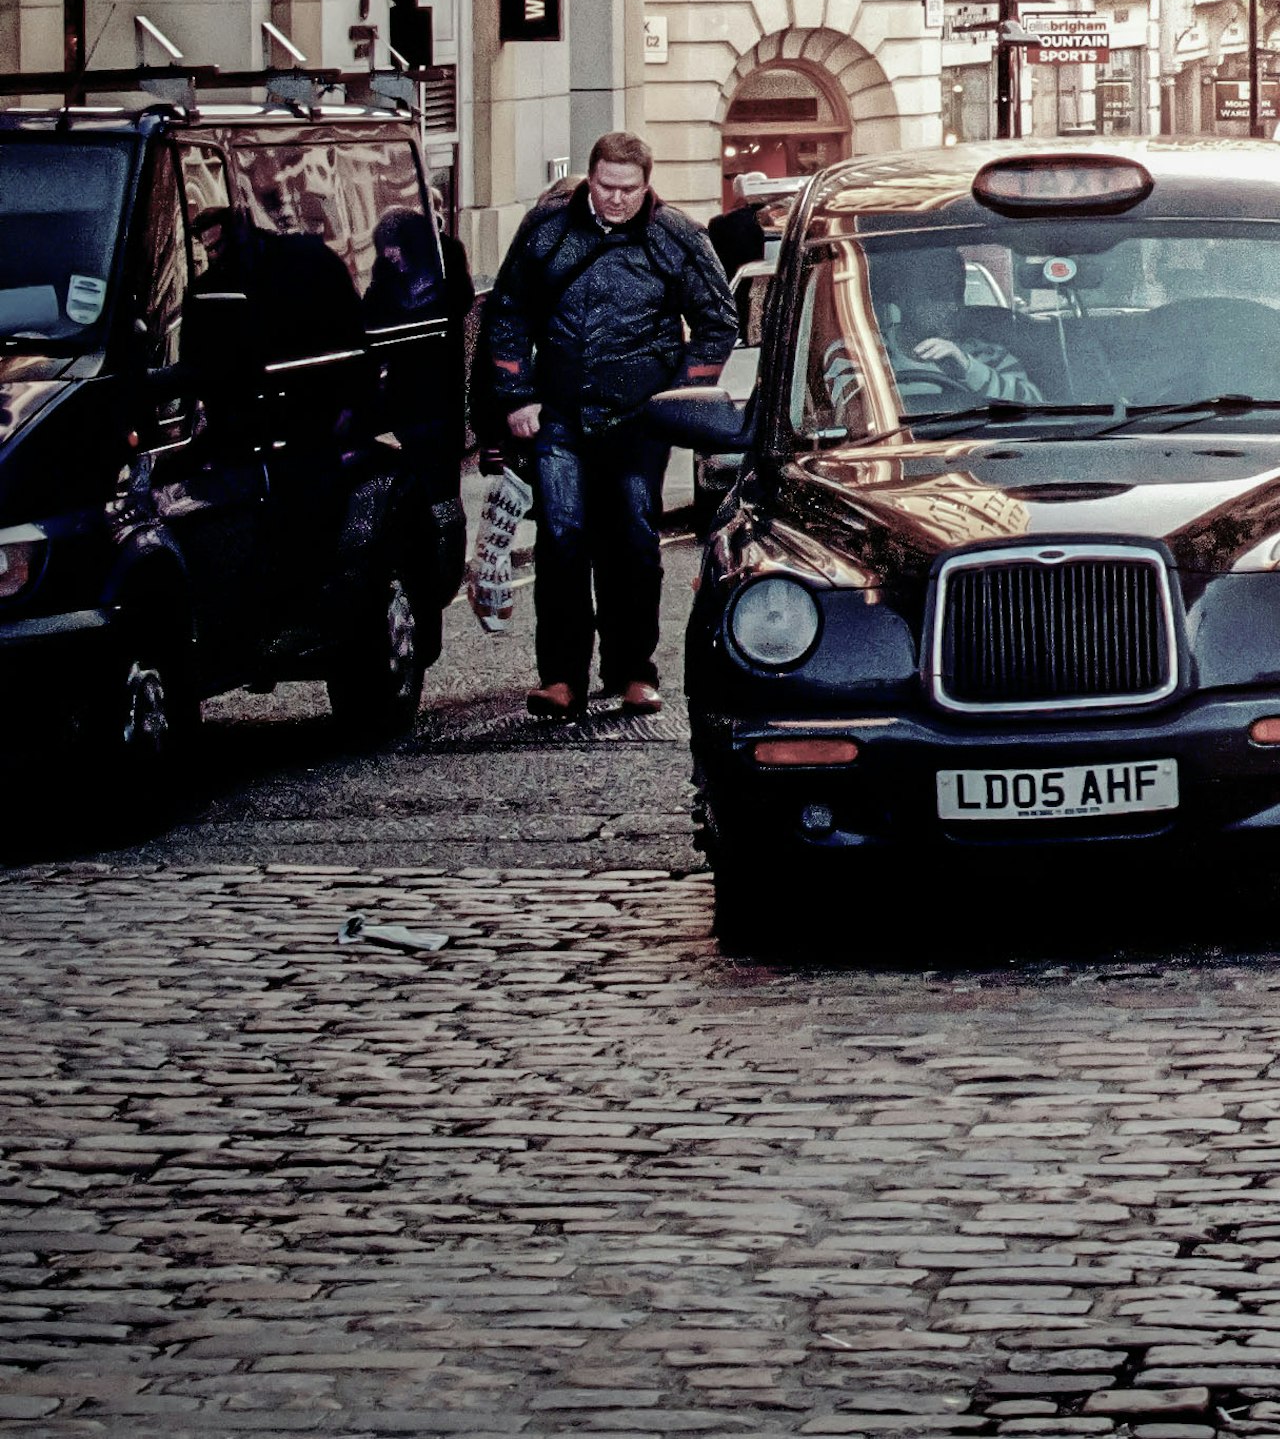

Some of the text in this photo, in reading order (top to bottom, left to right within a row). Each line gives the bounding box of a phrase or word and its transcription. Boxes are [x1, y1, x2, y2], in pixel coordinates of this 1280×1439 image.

[1042, 35, 1108, 48] OUNTAIN
[1039, 50, 1097, 63] SPORTS
[955, 764, 1159, 809] LD05 AHF
